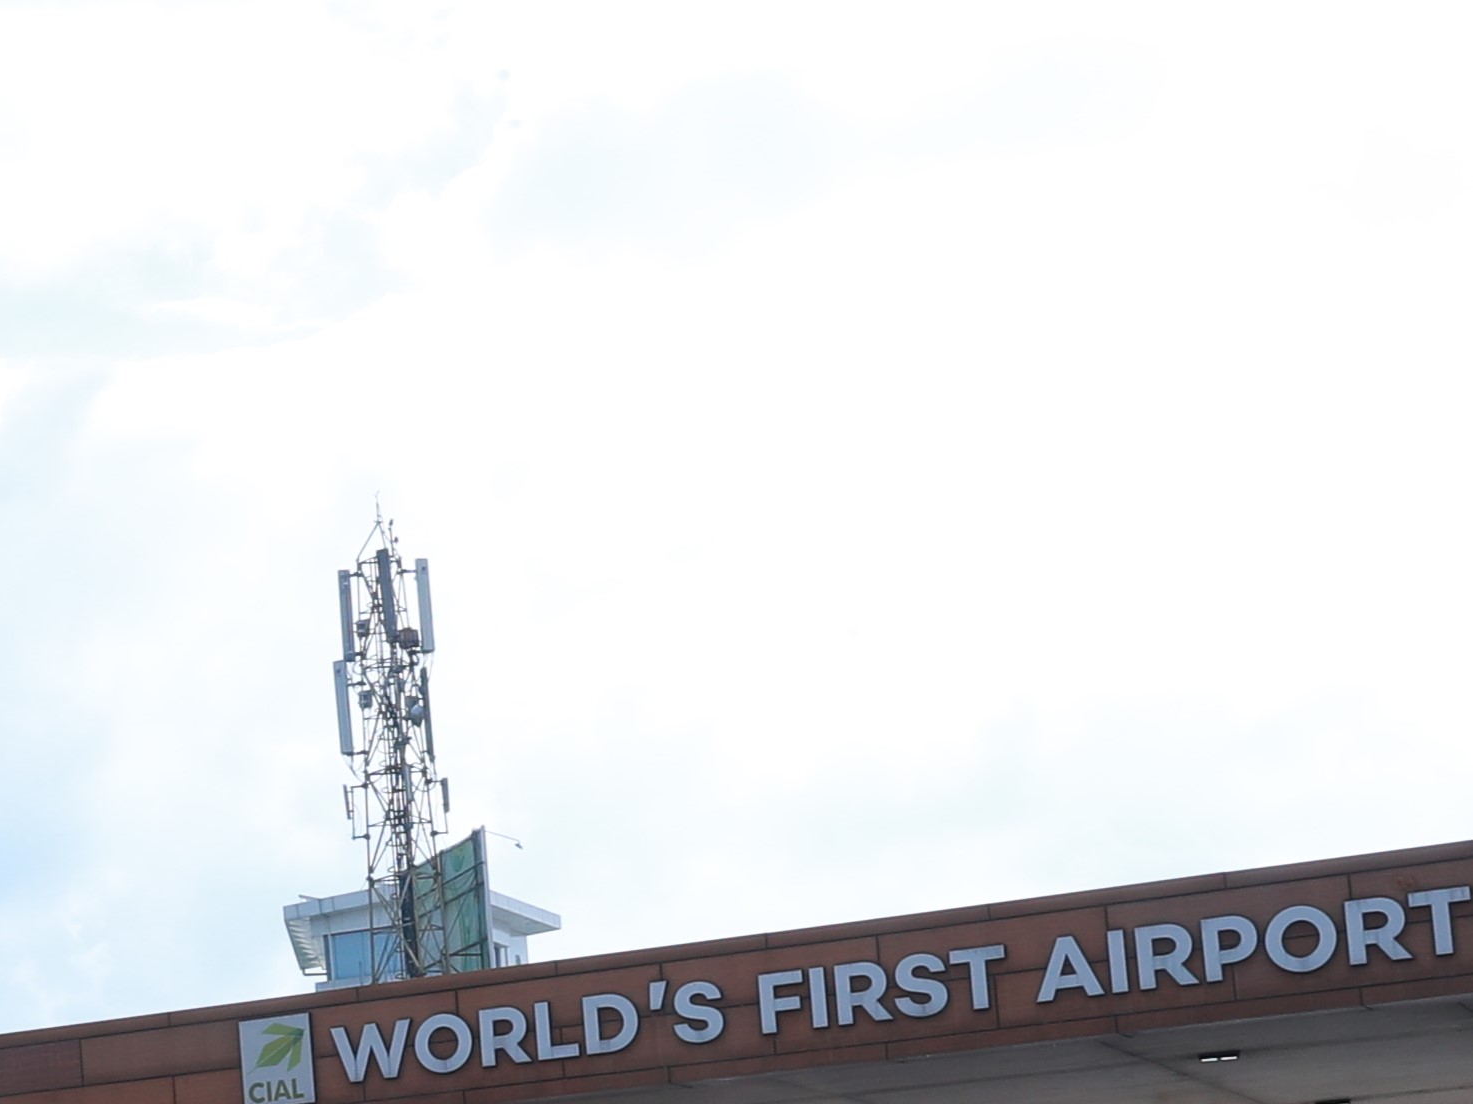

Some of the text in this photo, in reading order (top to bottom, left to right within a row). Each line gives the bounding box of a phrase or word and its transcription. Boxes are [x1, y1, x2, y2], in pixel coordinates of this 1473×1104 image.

[329, 886, 1472, 1083] WORLD'S FIRST AIRPORT
[248, 1078, 305, 1104] CIAL
